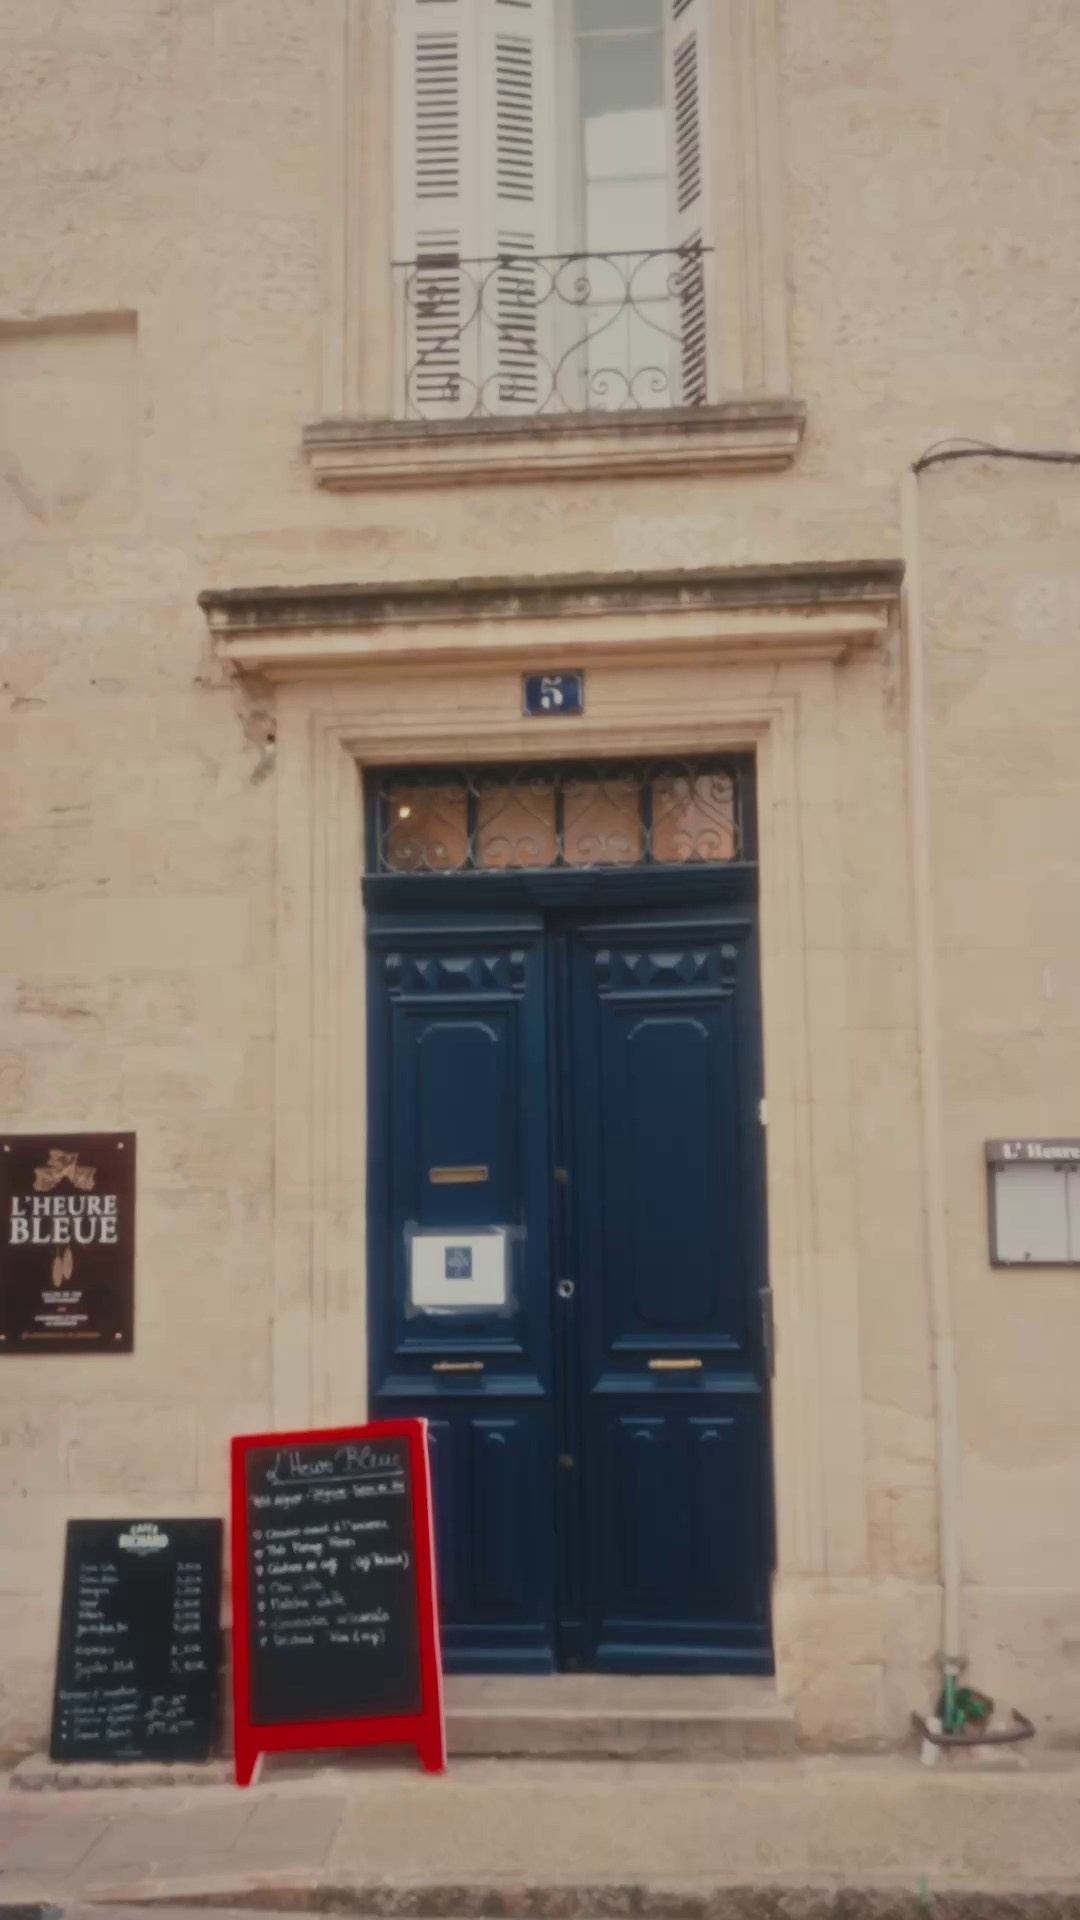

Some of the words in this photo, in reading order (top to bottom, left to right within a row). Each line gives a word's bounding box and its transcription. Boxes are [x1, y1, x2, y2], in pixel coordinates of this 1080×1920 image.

[541, 675, 564, 710] 5
[10, 1195, 118, 1217] L'HEURE
[9, 1216, 119, 1244] BLEUE
